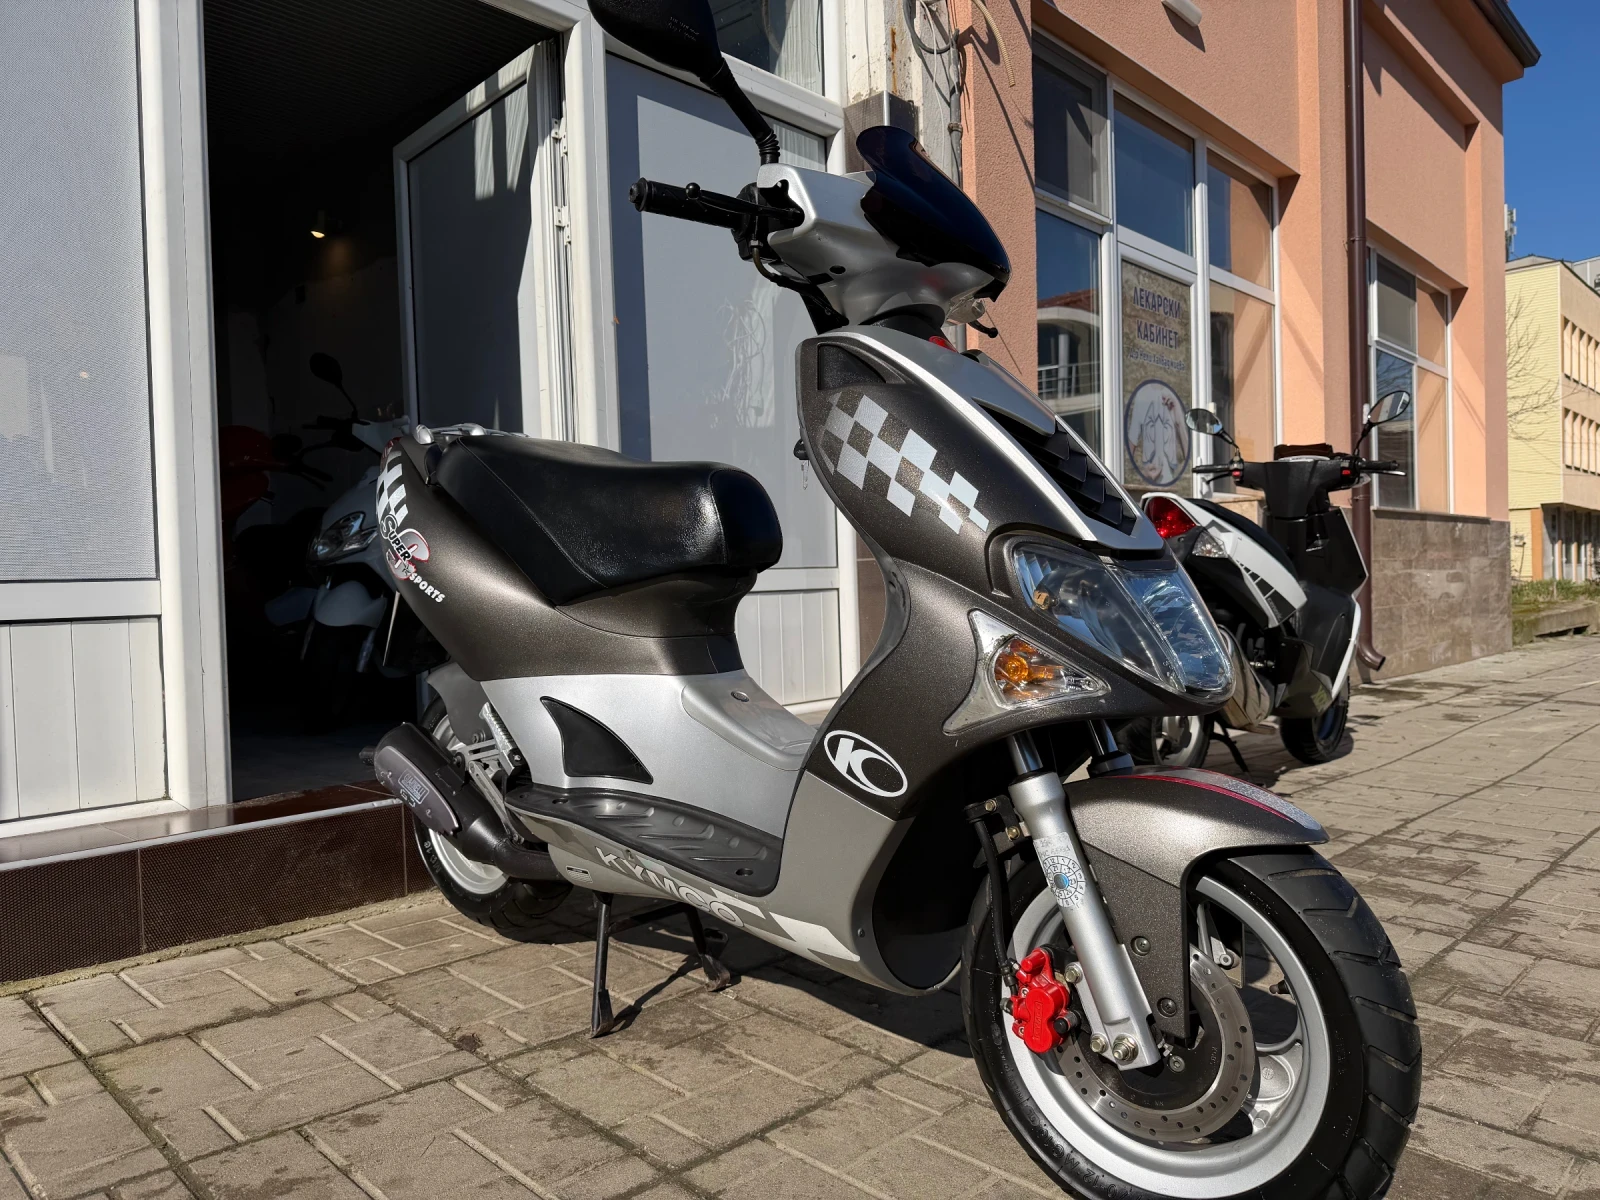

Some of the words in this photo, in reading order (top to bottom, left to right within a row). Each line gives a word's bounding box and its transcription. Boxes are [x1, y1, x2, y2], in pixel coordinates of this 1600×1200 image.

[1133, 286, 1182, 319] ЛЕКАРСКИ
[1136, 319, 1179, 350] КАБИНЕТ
[409, 572, 446, 603] SPORTS
[595, 846, 745, 928] KYMCO
